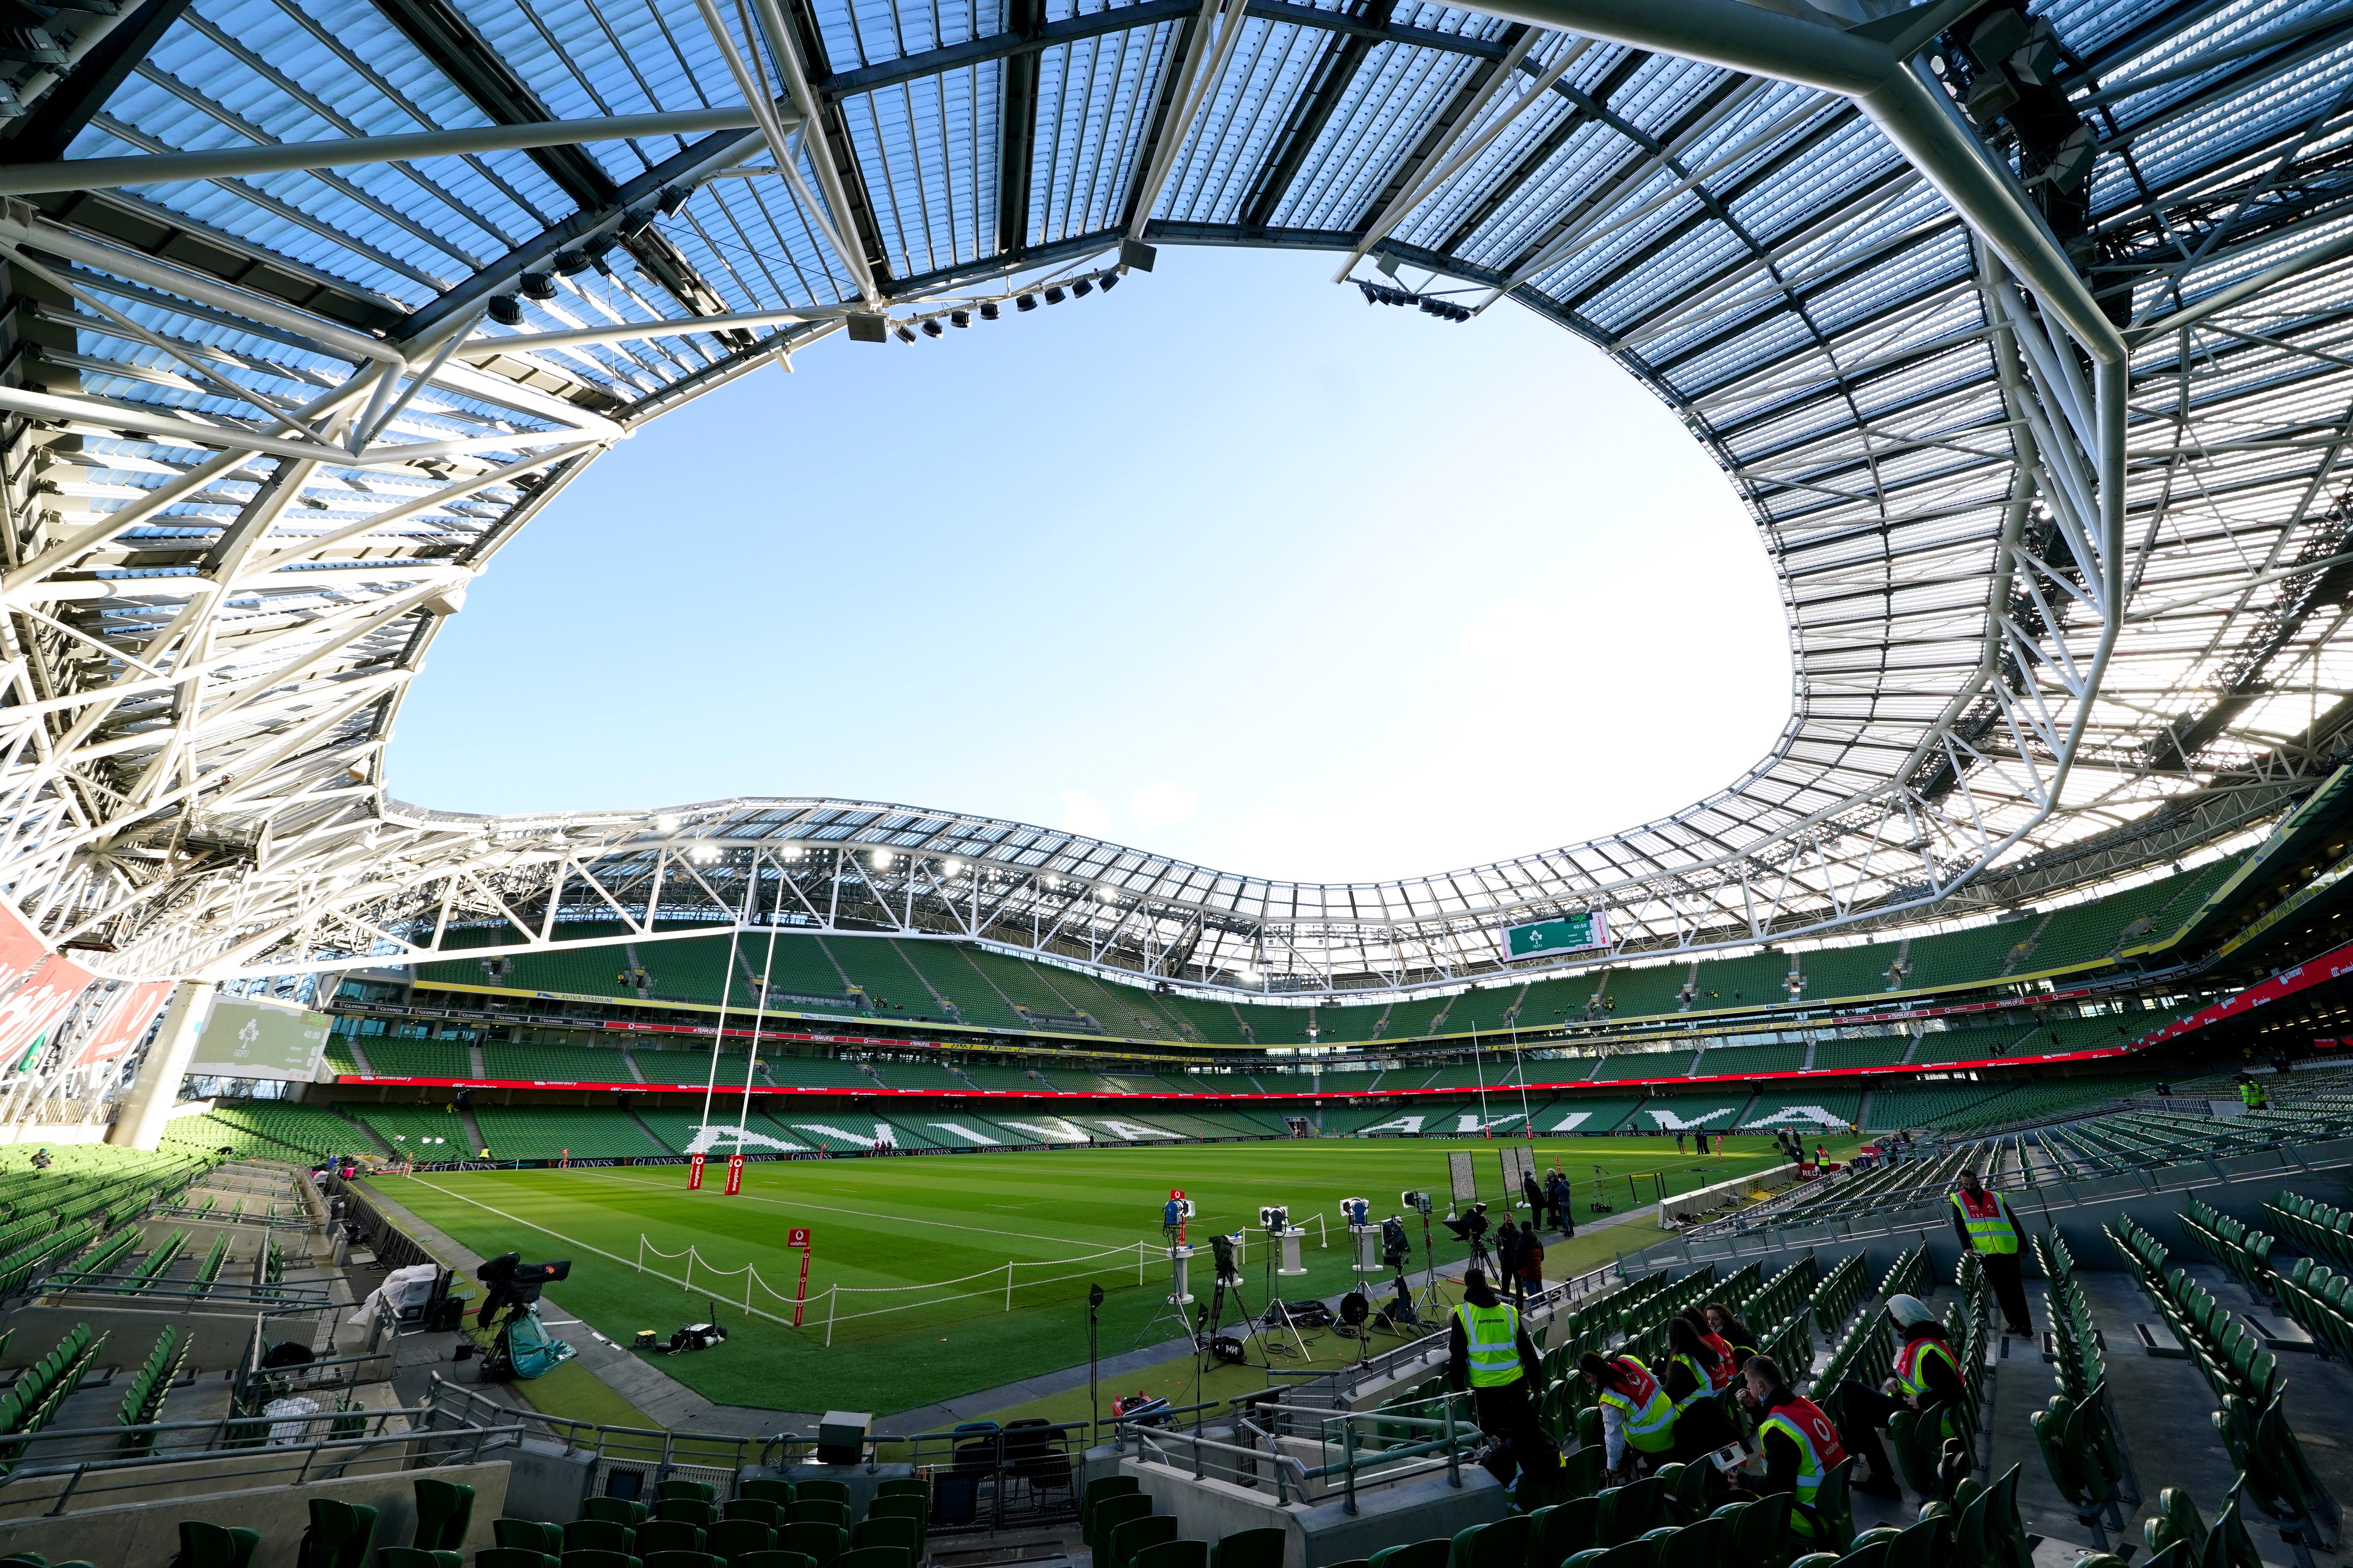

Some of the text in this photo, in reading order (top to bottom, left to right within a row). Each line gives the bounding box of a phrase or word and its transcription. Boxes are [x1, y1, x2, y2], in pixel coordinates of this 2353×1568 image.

[308, 1013, 328, 1026] sage
[303, 1030, 320, 1039] 40:00
[558, 1160, 614, 1168] GUINNESS
[633, 1157, 684, 1166] GUINNESS
[1226, 1345, 1237, 1354] HH
[1824, 1441, 1839, 1455] vodafone
